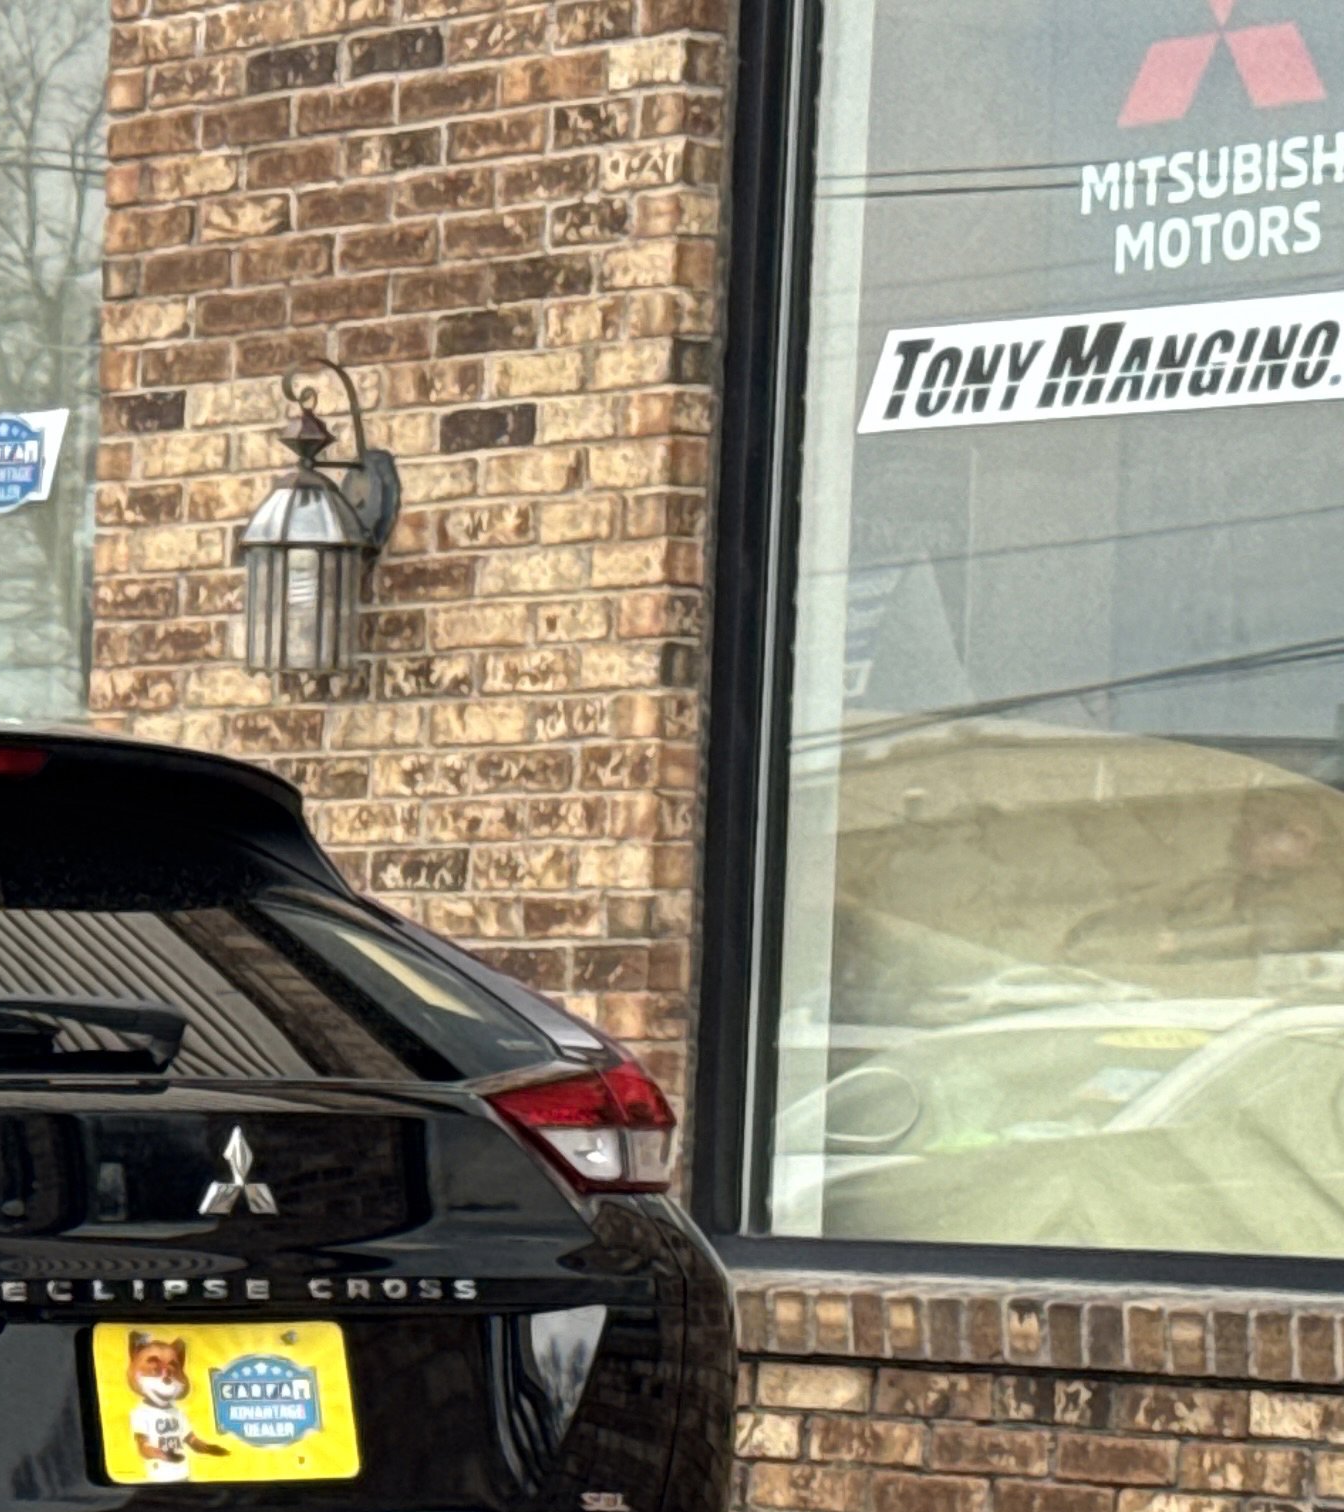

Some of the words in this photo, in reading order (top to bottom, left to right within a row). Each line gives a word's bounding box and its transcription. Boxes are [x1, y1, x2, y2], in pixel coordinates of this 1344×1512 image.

[1079, 131, 1344, 216] MITSUBISH
[1114, 200, 1322, 275] MOTORS
[882, 337, 1047, 421] TONY
[0, 1278, 271, 1301] ECLIPSE
[308, 1278, 478, 1300] CROSS
